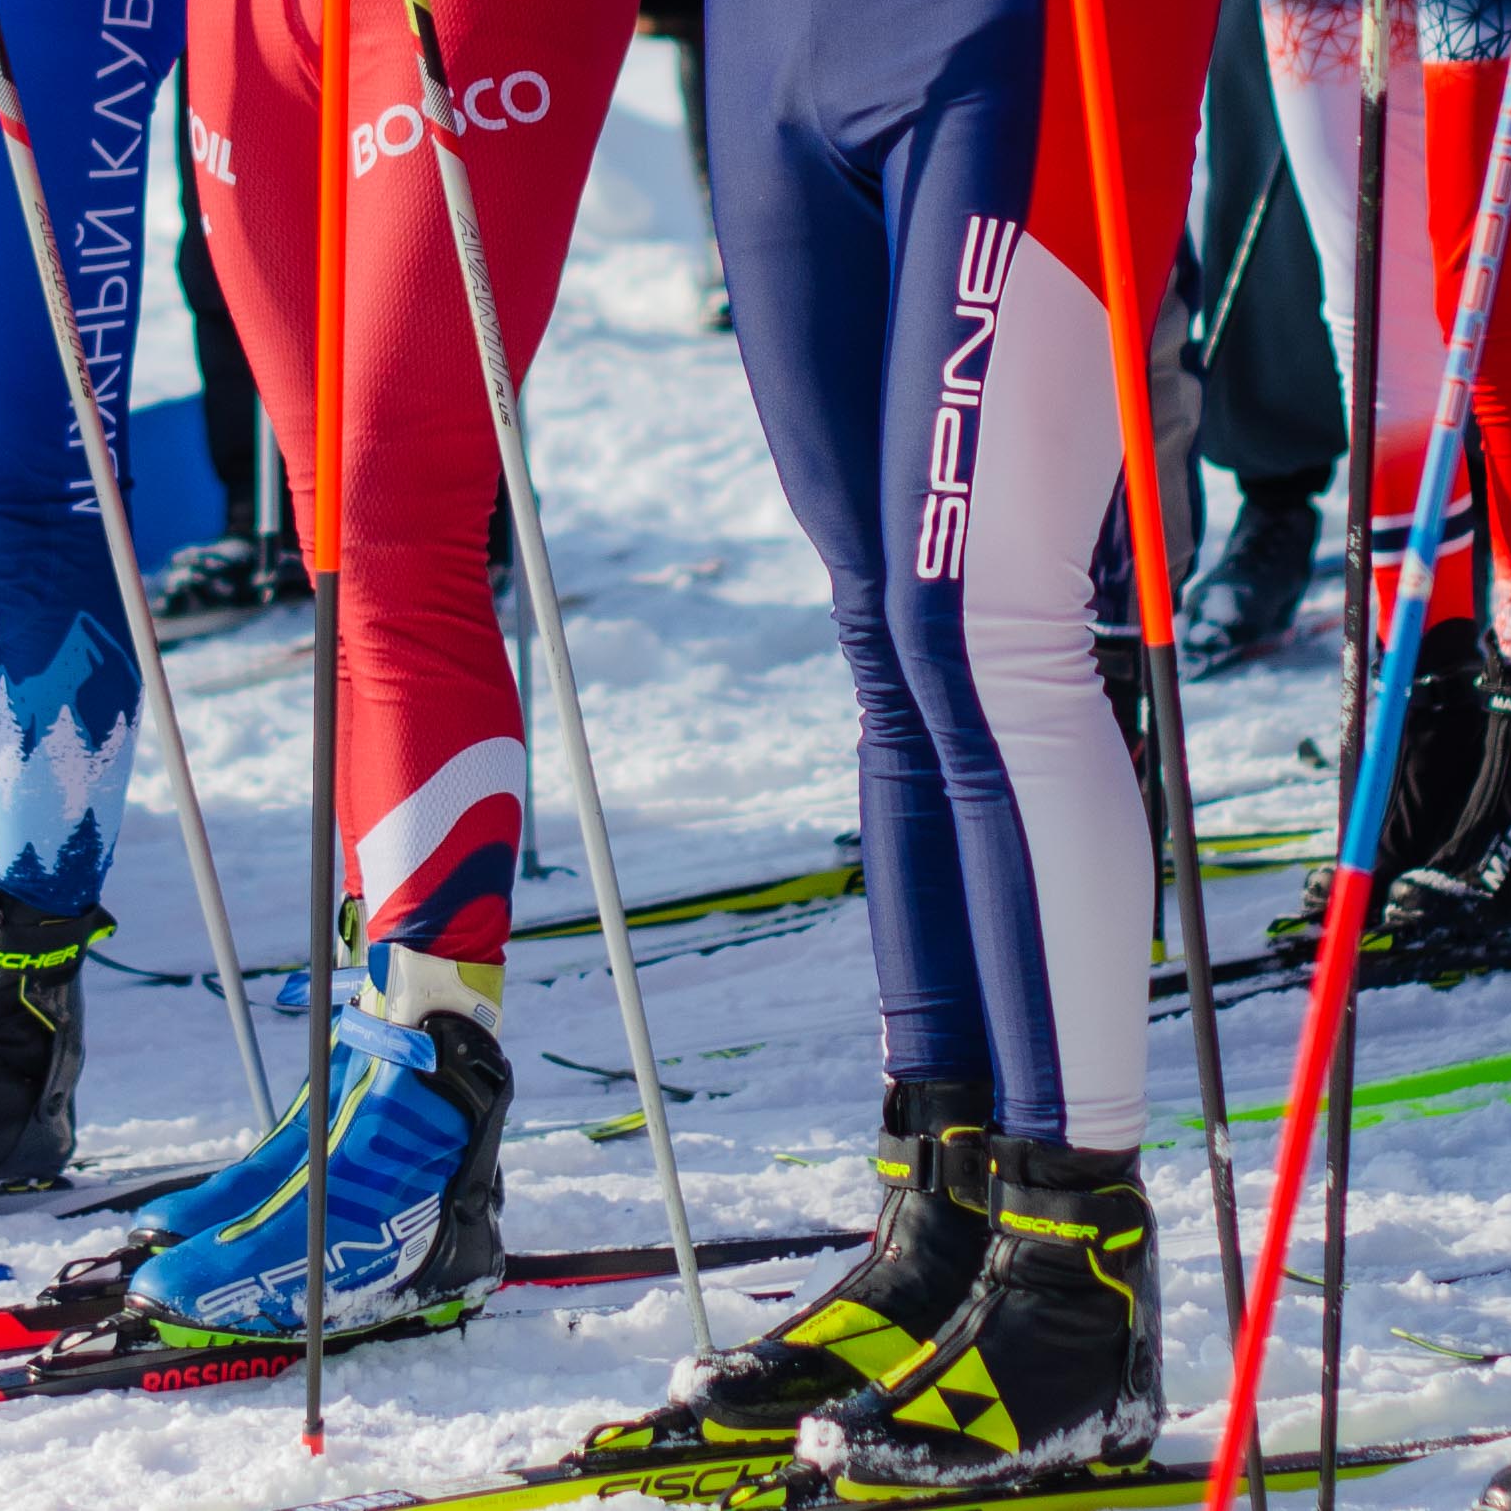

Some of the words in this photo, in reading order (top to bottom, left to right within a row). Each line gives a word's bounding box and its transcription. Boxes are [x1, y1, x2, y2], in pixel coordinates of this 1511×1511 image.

[189, 106, 237, 186] OIL
[456, 210, 510, 378] AVANTI
[491, 377, 512, 428] PLUS
[73, 355, 94, 400] PLUS
[917, 214, 1017, 580] SPINE
[998, 1209, 1100, 1240] FISCHER
